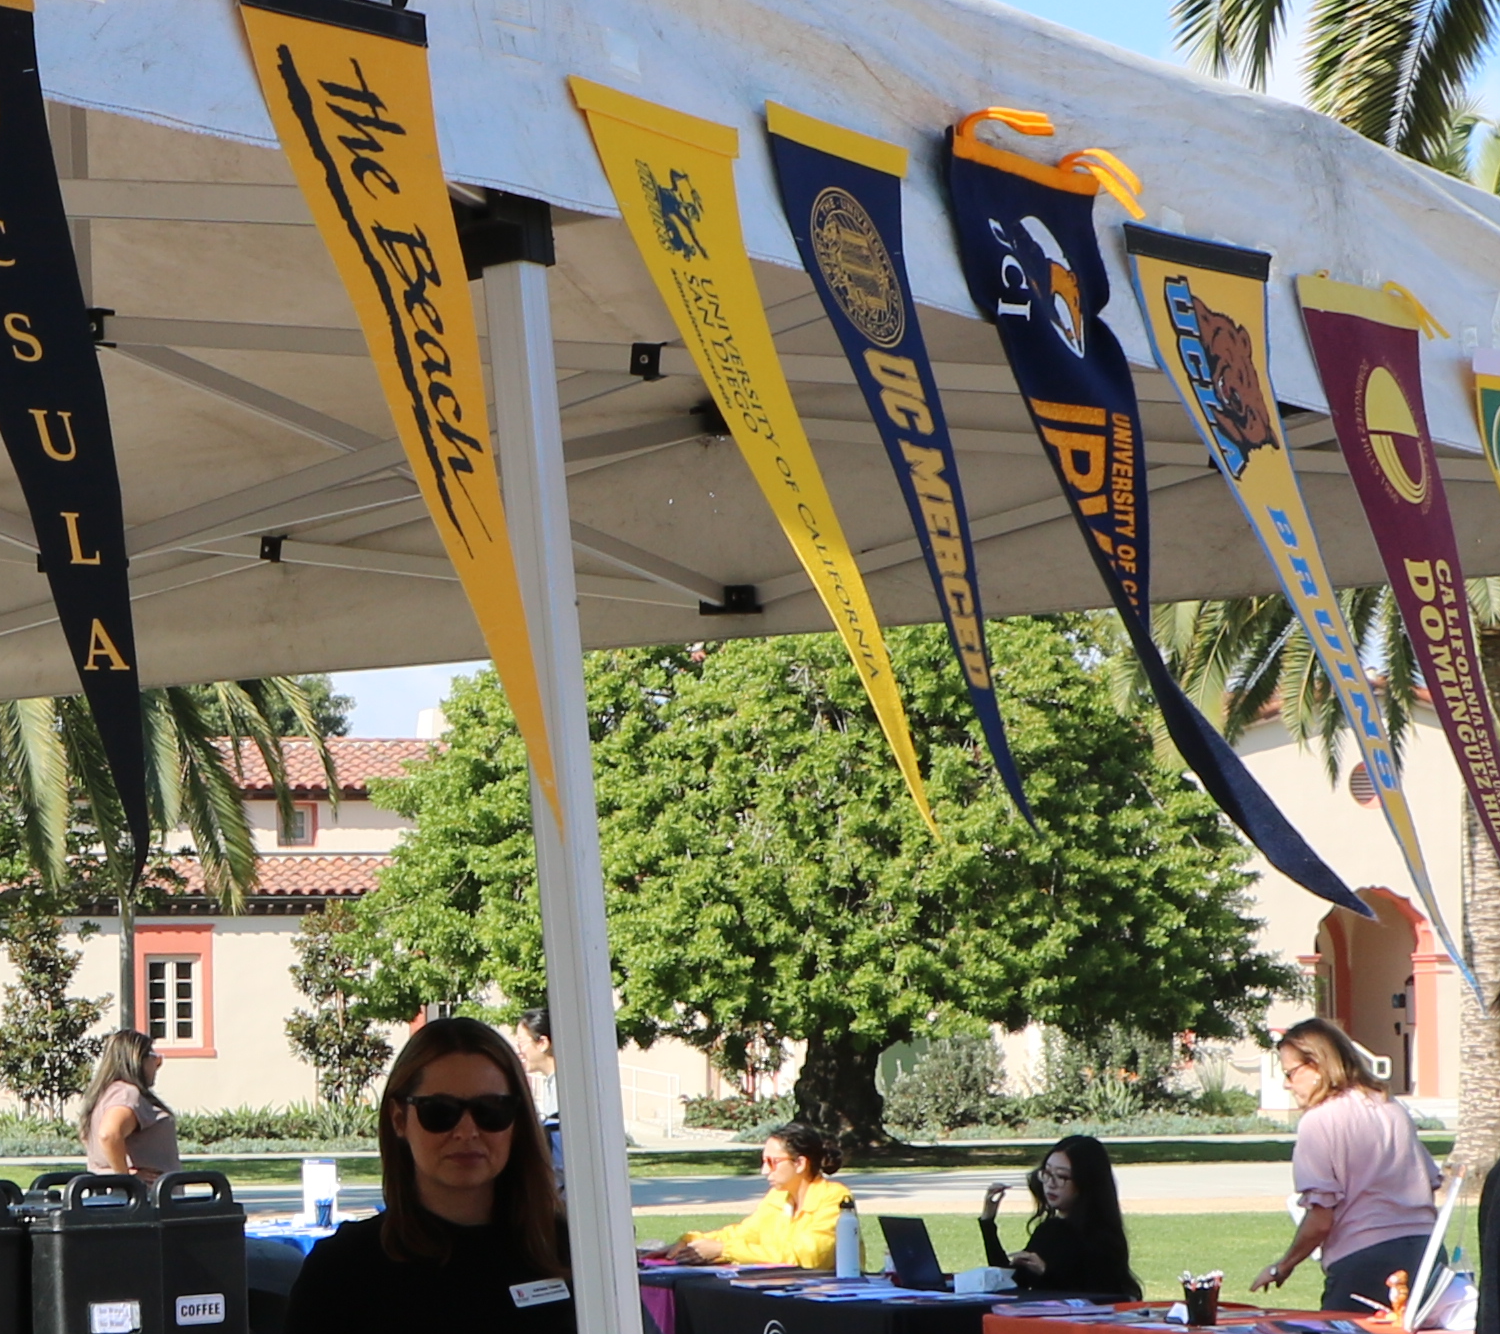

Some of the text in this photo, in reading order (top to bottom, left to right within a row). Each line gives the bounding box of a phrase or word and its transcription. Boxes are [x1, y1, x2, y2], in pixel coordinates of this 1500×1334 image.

[684, 271, 758, 434] SAN DIEGO
[988, 218, 1031, 322] UCI
[370, 221, 492, 542] Beach
[701, 278, 880, 679] UNIVERSITY OF CALIFORNIA
[1112, 413, 1136, 538] UNIVERSITY
[1164, 277, 1249, 480] UCLA
[862, 348, 992, 691] UC MERCED
[1117, 545, 1137, 574] OF
[1266, 506, 1400, 791] BRUINS
[1404, 558, 1492, 789] DOMINGUEZ
[1436, 559, 1484, 727] CALIFORNIA
[1478, 729, 1500, 778] STATE
[181, 1301, 221, 1318] COFFEE
